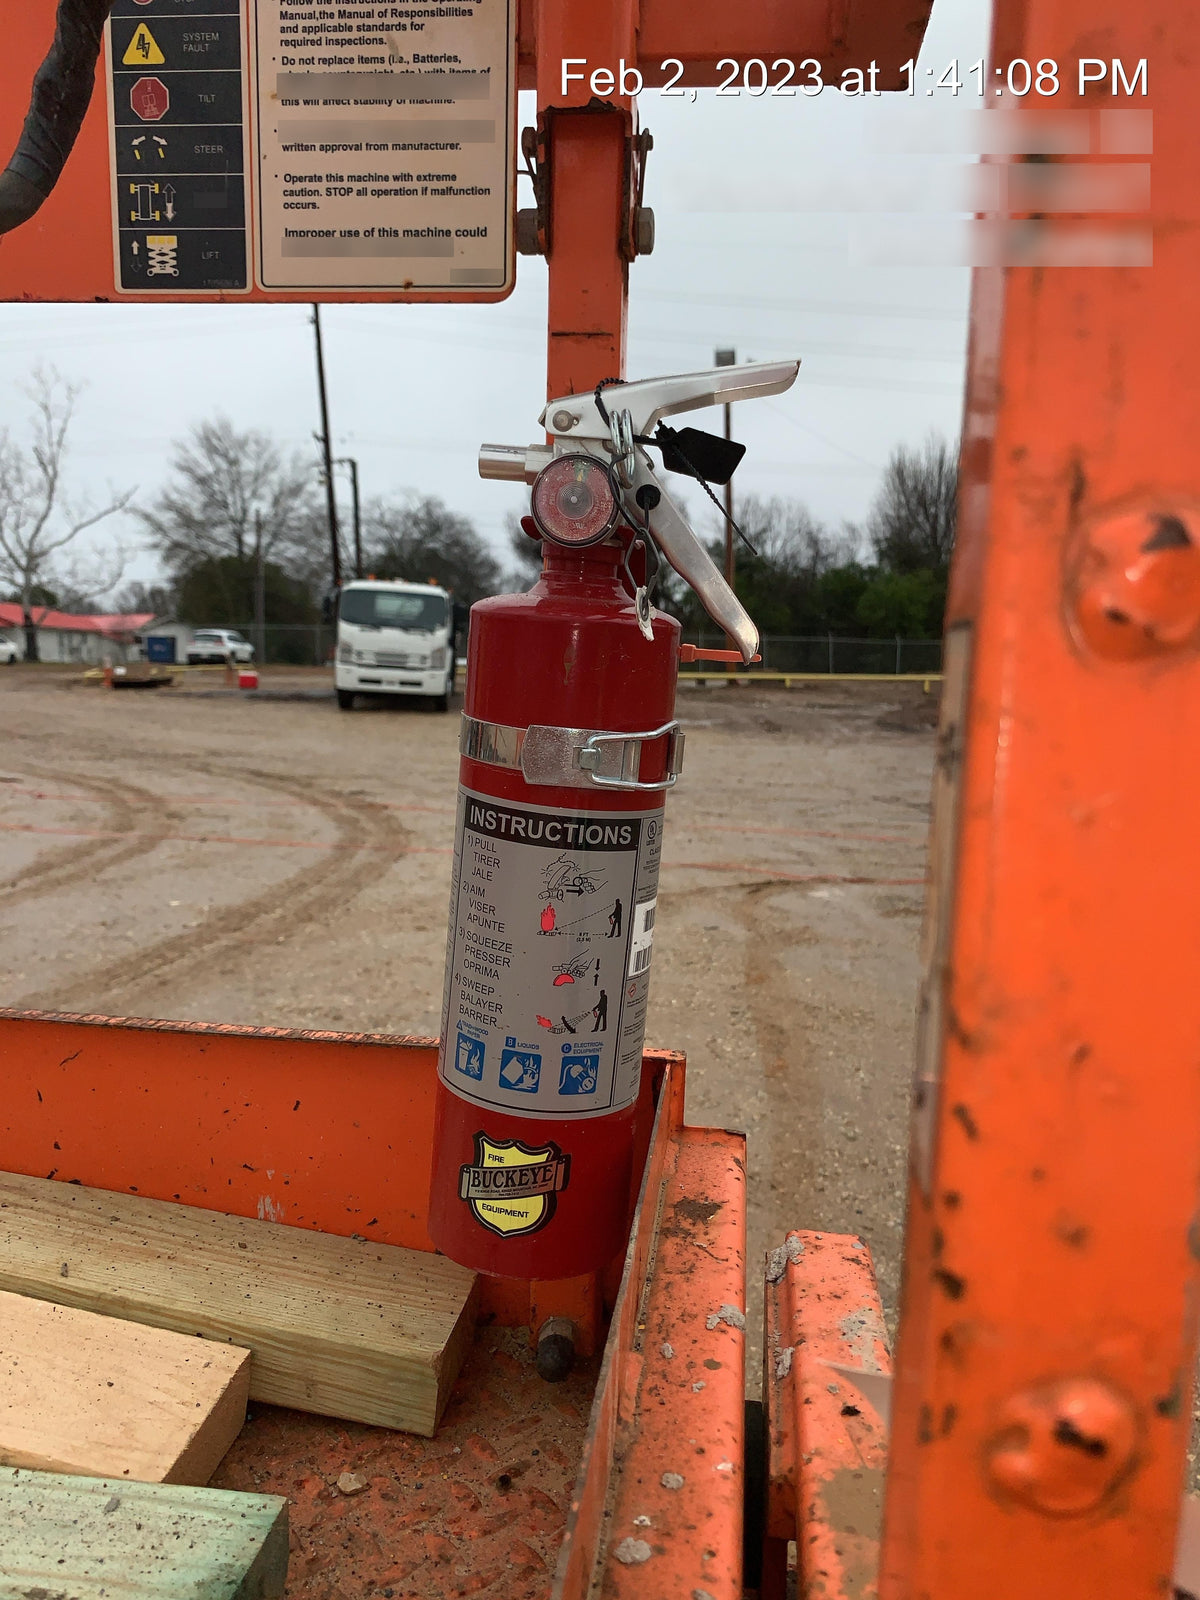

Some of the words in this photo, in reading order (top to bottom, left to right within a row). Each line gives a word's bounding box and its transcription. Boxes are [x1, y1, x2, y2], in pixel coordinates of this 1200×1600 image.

[338, 9, 374, 19] Manual
[377, 9, 388, 18] of
[390, 7, 473, 19] Responsibilities
[280, 24, 299, 33] and
[301, 23, 353, 35] applicable
[356, 22, 407, 32] standards
[410, 21, 425, 31] for
[182, 32, 220, 42] SYSTEM
[280, 37, 322, 48] required
[325, 36, 387, 48] inspections.
[182, 43, 210, 52] FAULT
[281, 56, 296, 66] Do
[298, 56, 315, 65] not
[317, 56, 355, 67] replace
[357, 55, 386, 64] items
[412, 53, 461, 64] Batteries,
[198, 94, 216, 103] TILT
[194, 145, 224, 154] STEER
[281, 142, 316, 152] written
[319, 142, 363, 154] approval
[365, 142, 389, 151] from
[391, 142, 462, 151] manufacturer.
[283, 173, 323, 185] Operate
[325, 173, 345, 183] this
[347, 172, 390, 182] machine
[392, 172, 414, 182] with
[416, 173, 457, 182] extreme
[282, 187, 323, 197] caution.
[325, 186, 354, 197] STOP
[356, 186, 368, 197] all
[370, 186, 419, 198] operation
[421, 186, 428, 196] if
[430, 185, 491, 196] malfunction
[282, 201, 320, 210] occurs.
[284, 227, 337, 238] Improper
[339, 228, 361, 238] use
[363, 227, 375, 238] of
[377, 227, 399, 238] this
[402, 227, 452, 238] machine
[454, 226, 488, 238] could
[201, 251, 219, 260] LIFT
[470, 804, 632, 845] INSTRUCTIONS
[475, 837, 497, 853] PULL
[473, 851, 501, 869] TIRER
[471, 866, 493, 881] JALE
[470, 884, 486, 898] AIM
[469, 898, 496, 916] VISER
[467, 912, 505, 933] APUNTE
[466, 930, 513, 954] SQUEEZE
[465, 944, 511, 968] PRESSER
[463, 958, 500, 980] OPRIMA
[462, 976, 495, 996] SWEEP
[460, 990, 503, 1015] BALAYER
[459, 1003, 497, 1027] BARRER
[487, 1153, 505, 1164] FIRE
[471, 1164, 553, 1188] BUCKEYE
[481, 1202, 530, 1219] EQUIPMENT
